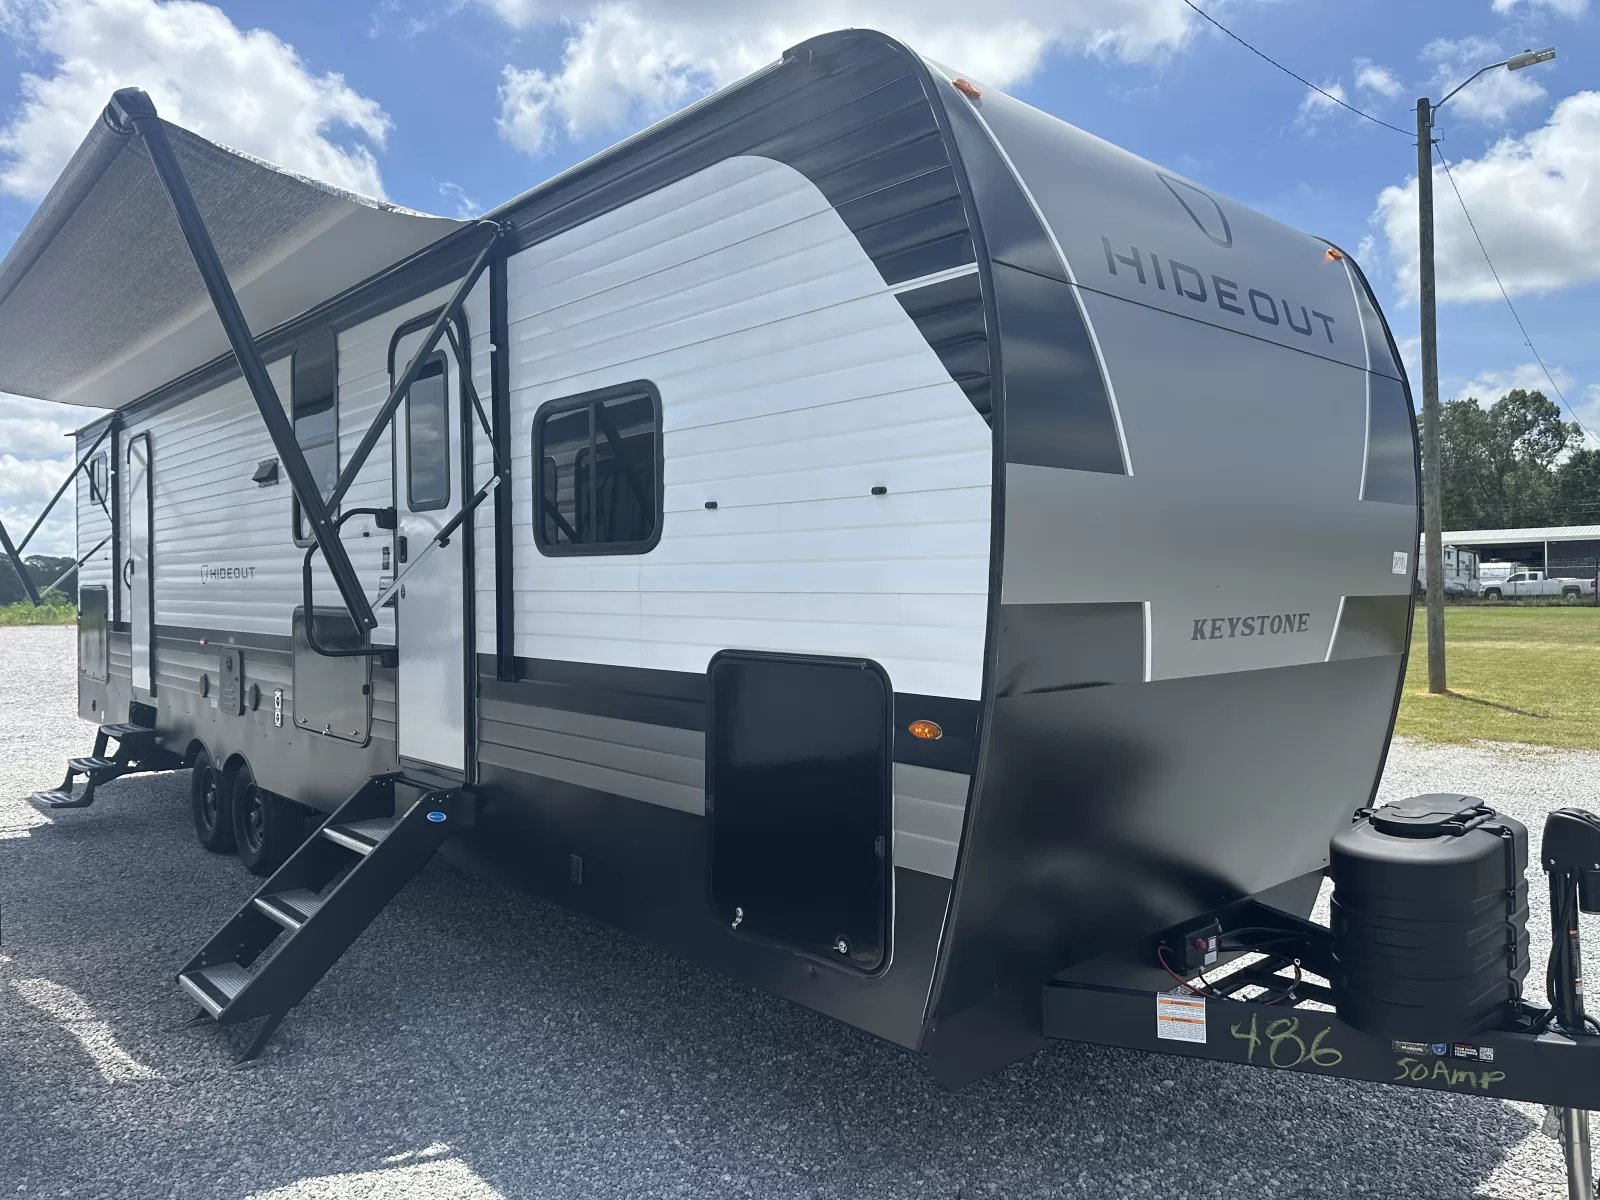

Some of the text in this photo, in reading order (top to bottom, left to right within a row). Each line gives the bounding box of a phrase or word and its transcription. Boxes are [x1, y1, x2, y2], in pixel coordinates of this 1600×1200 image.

[1101, 235, 1335, 344] HIDEOUT
[210, 567, 255, 579] HIDEOUT
[1191, 612, 1310, 641] KEYSTONE
[1230, 1012, 1342, 1068] 486
